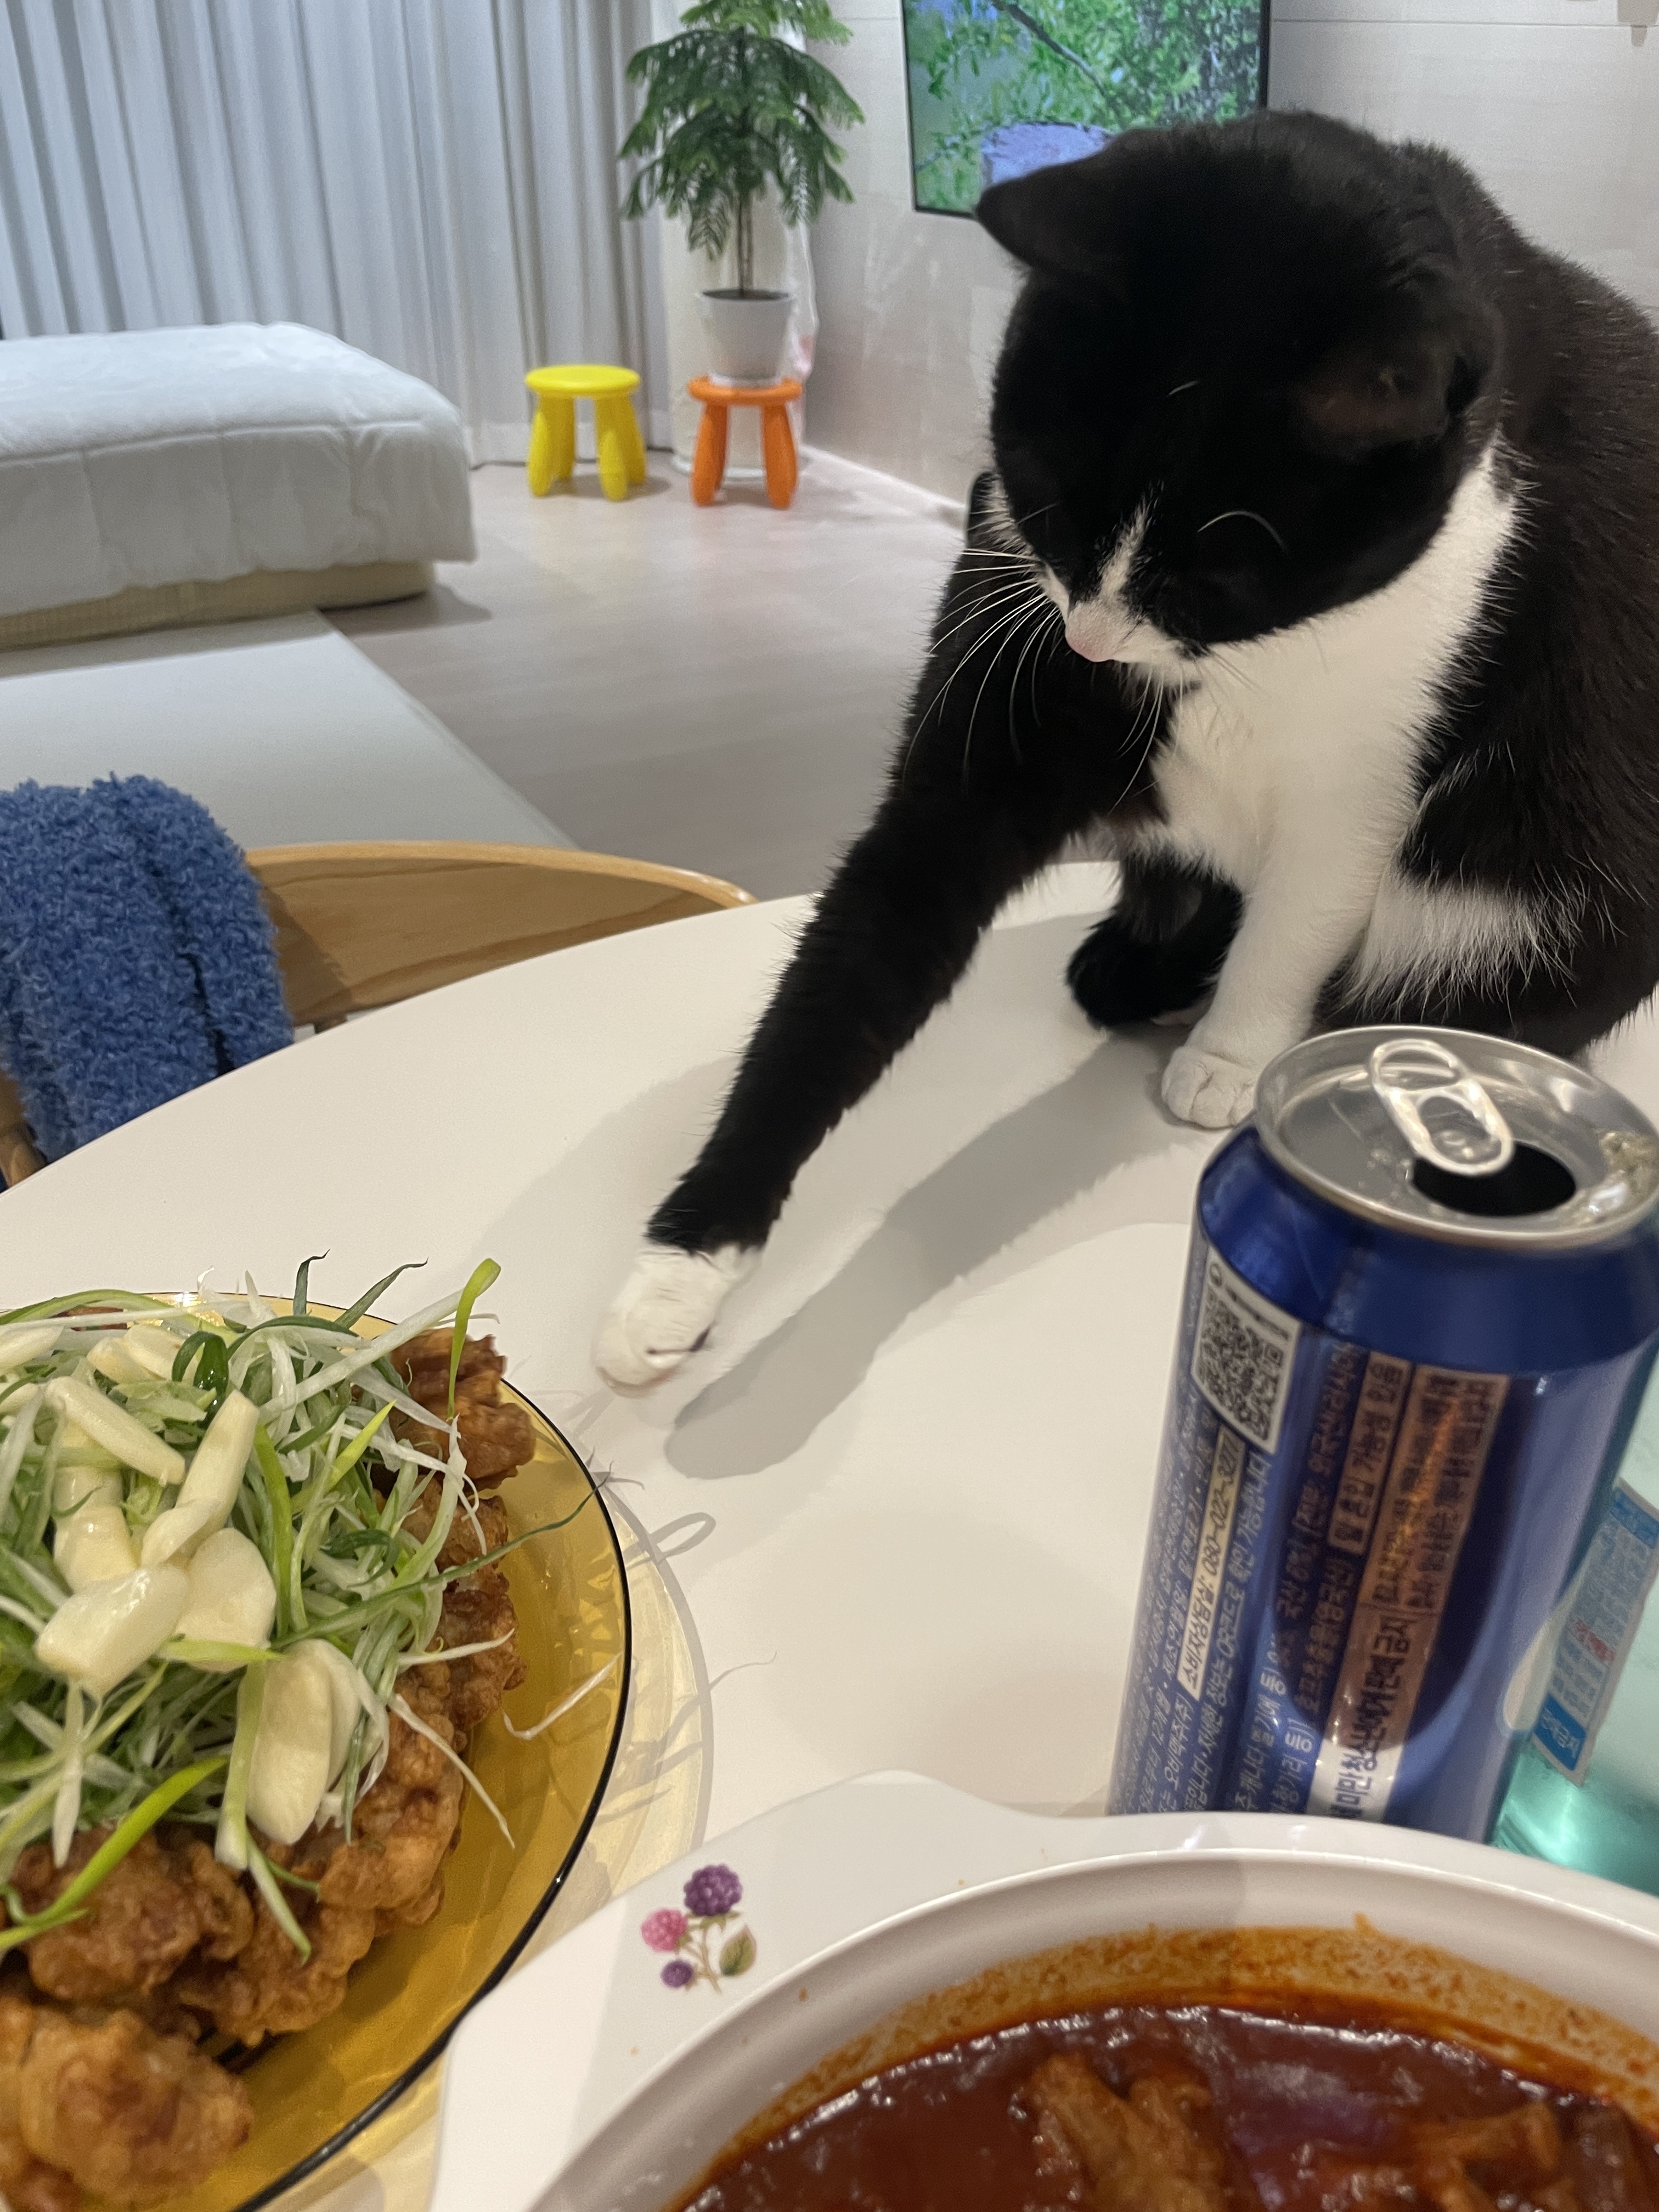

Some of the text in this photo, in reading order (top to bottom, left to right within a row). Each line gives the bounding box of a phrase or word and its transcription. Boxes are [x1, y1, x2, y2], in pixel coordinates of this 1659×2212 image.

[1161, 1691, 1195, 1791] 오비맥주(주)
[1180, 1574, 1217, 1690] 소비자상담실:
[1200, 1432, 1240, 1577] 080-022-3277
